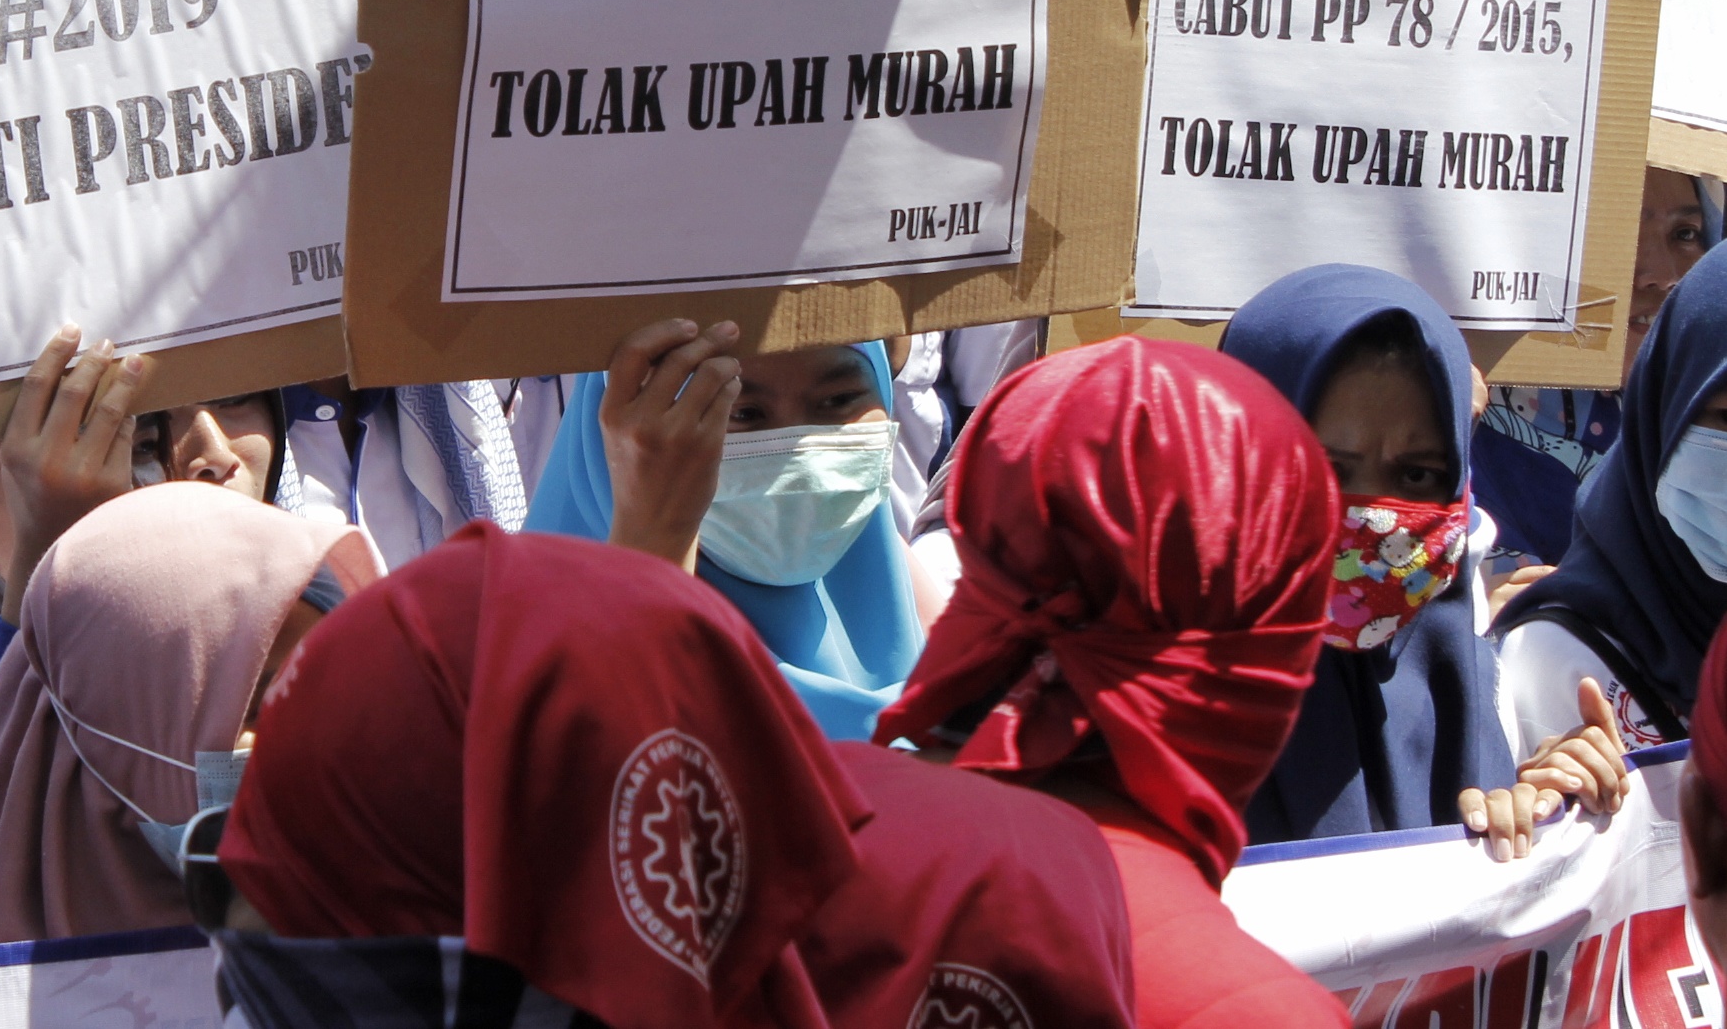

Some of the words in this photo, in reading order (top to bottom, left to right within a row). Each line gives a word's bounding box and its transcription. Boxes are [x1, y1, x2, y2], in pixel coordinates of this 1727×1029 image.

[65, 52, 372, 193] PRESIDE
[490, 64, 668, 138] TOLAK
[687, 56, 827, 131] UPAH
[842, 44, 1018, 122] MURAH
[1159, 116, 1298, 182] TOLAK
[1311, 125, 1429, 188] UPAH
[1438, 131, 1569, 193] MURAH
[887, 200, 982, 243] PUK-JAI
[287, 242, 344, 287] PUK
[1471, 269, 1541, 302] PUK-JAI
[616, 759, 654, 854] SERIKAT
